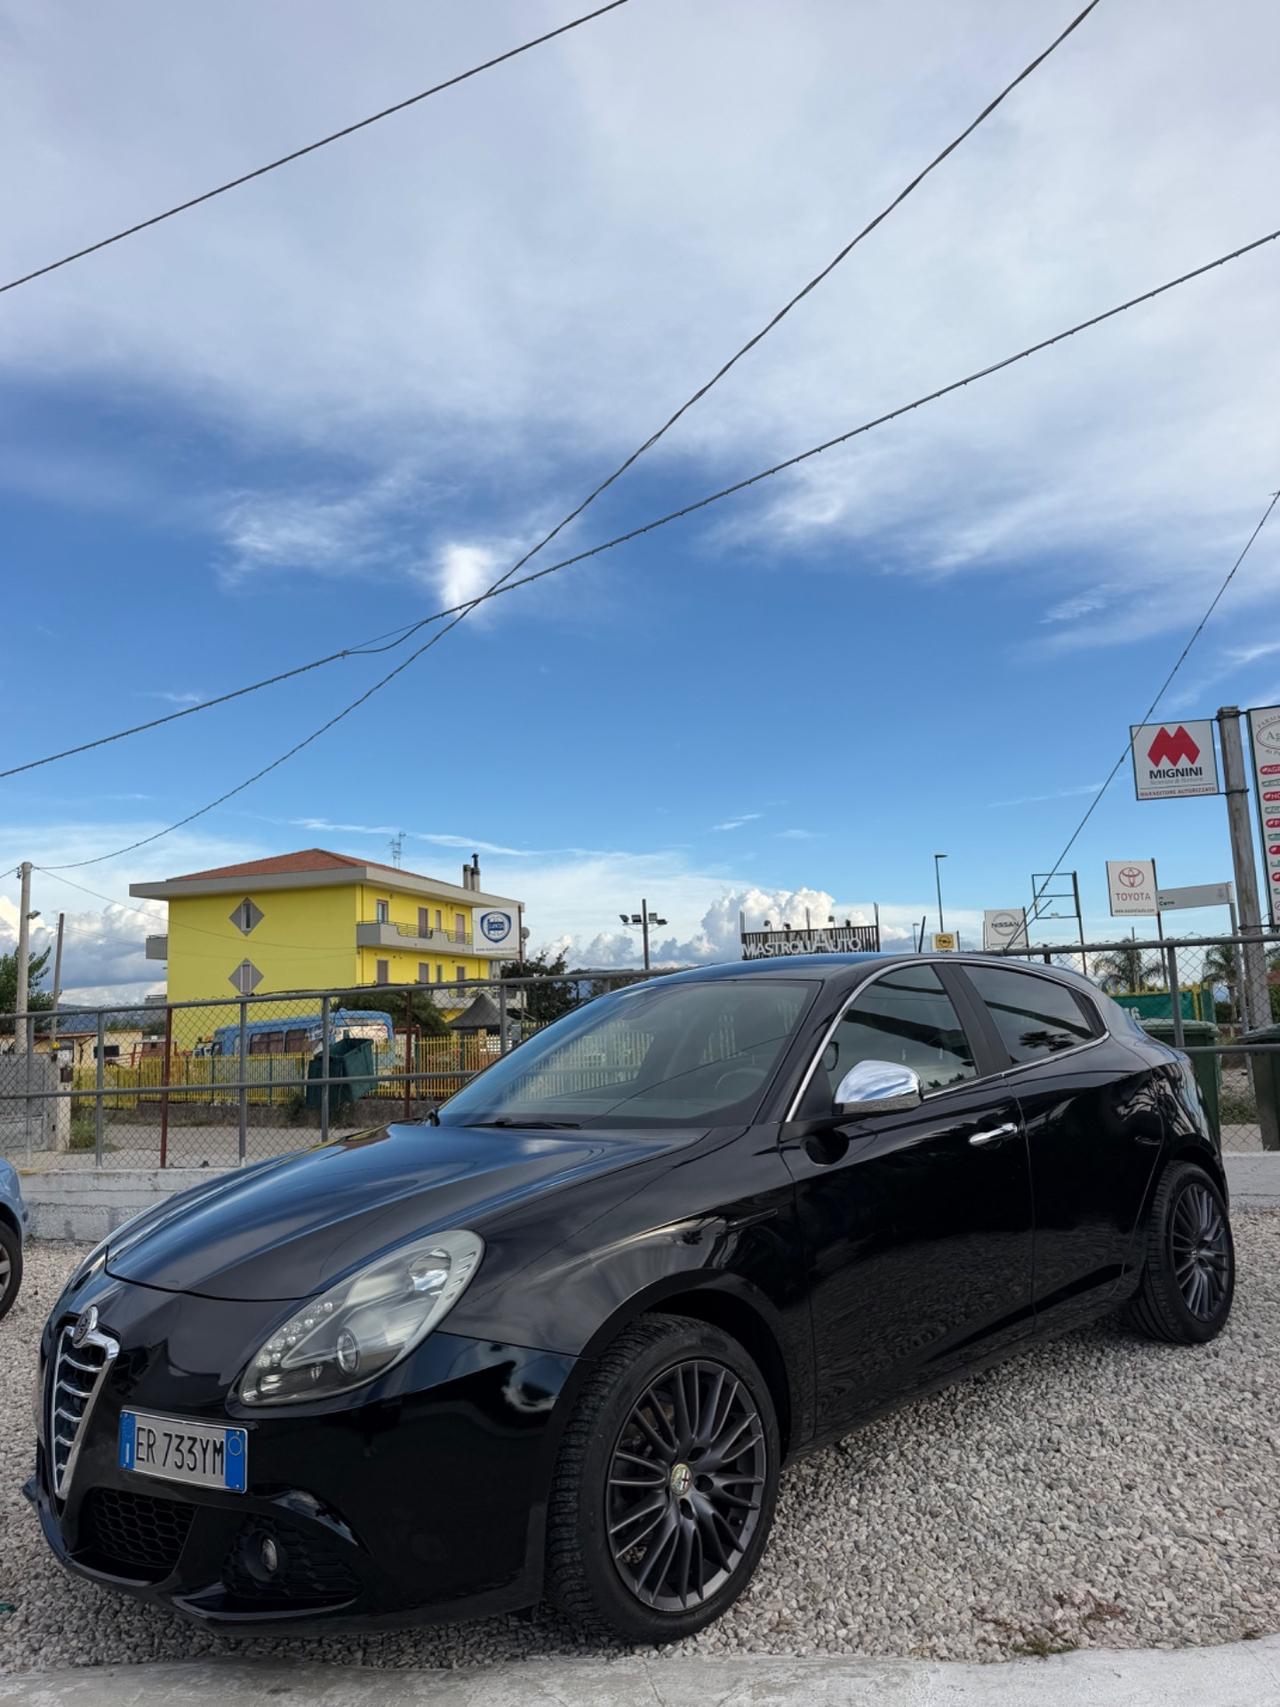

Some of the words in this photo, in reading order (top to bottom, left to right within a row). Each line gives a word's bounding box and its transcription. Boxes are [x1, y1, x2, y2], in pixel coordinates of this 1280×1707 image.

[1149, 767, 1203, 779] MIGNINI
[1115, 892, 1152, 901] TOYOTA
[991, 920, 1020, 929] NISSAN
[135, 1426, 156, 1464] ER
[162, 1432, 224, 1476] 733YM
